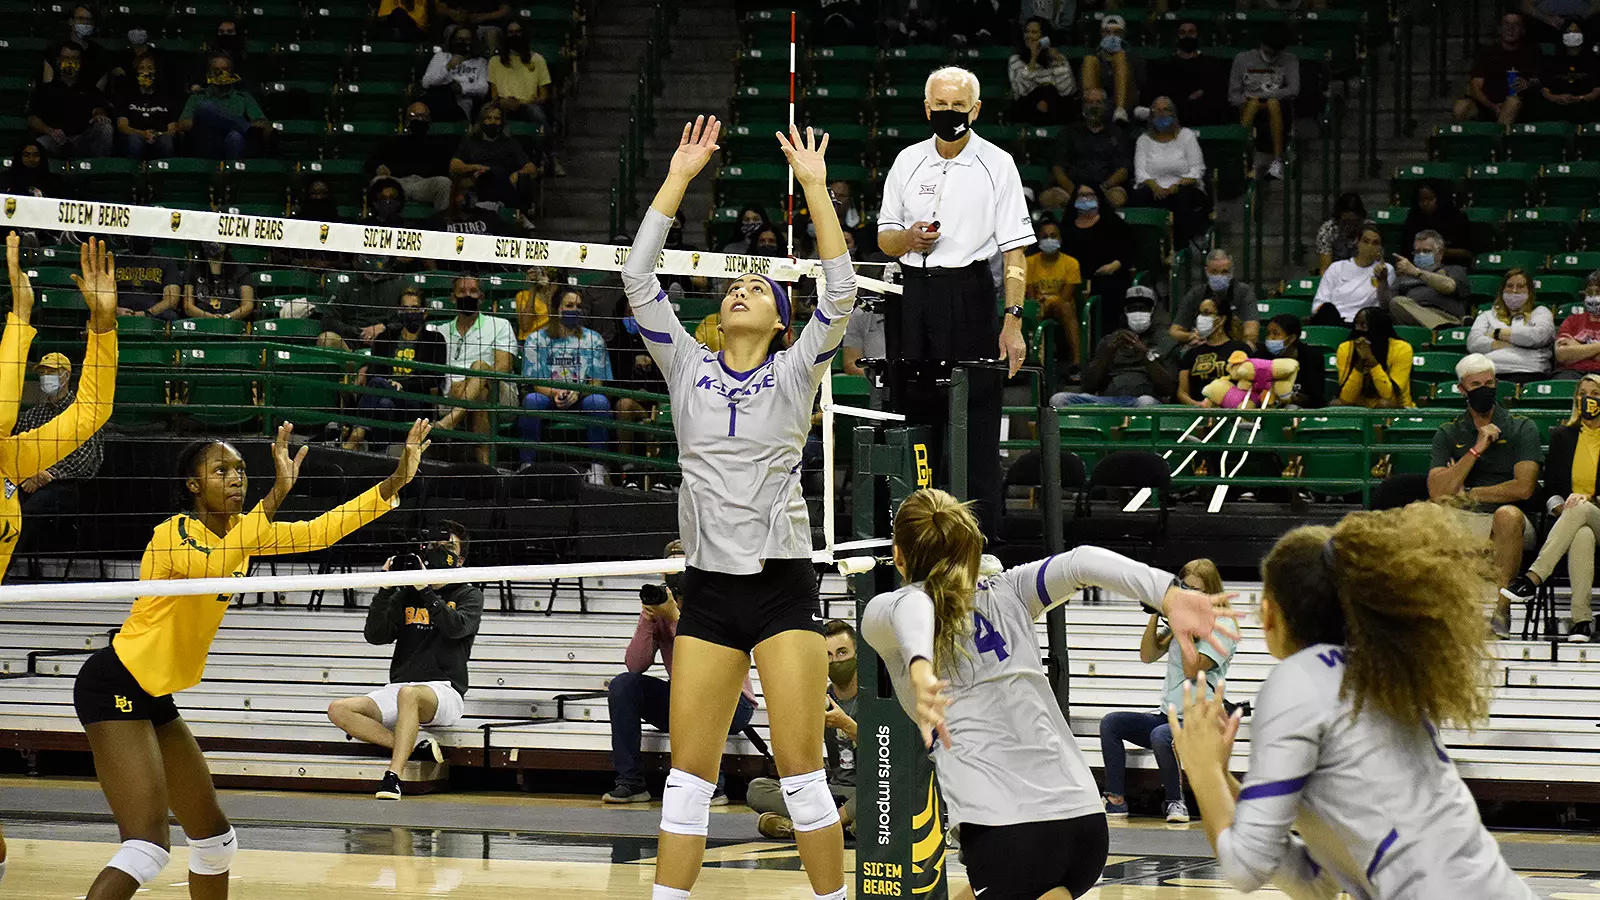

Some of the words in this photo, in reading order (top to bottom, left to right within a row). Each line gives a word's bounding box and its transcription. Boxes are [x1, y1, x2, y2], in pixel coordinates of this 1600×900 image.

[58, 201, 93, 225] SIC'EM
[98, 205, 130, 228] BEARS
[218, 215, 251, 238] SIC'EM
[254, 219, 284, 240] BEARS
[363, 228, 392, 248] SIC'EM
[396, 231, 422, 251] BEARS
[495, 238, 522, 259] SIC'EM
[525, 242, 549, 260] BEARS
[749, 257, 771, 274] BEARS
[727, 402, 737, 437] 1
[974, 610, 1010, 662] 4
[876, 725, 892, 778] sports
[876, 780, 892, 845] imports
[863, 861, 902, 878] SIC'EM
[863, 879, 902, 897] BEARS
